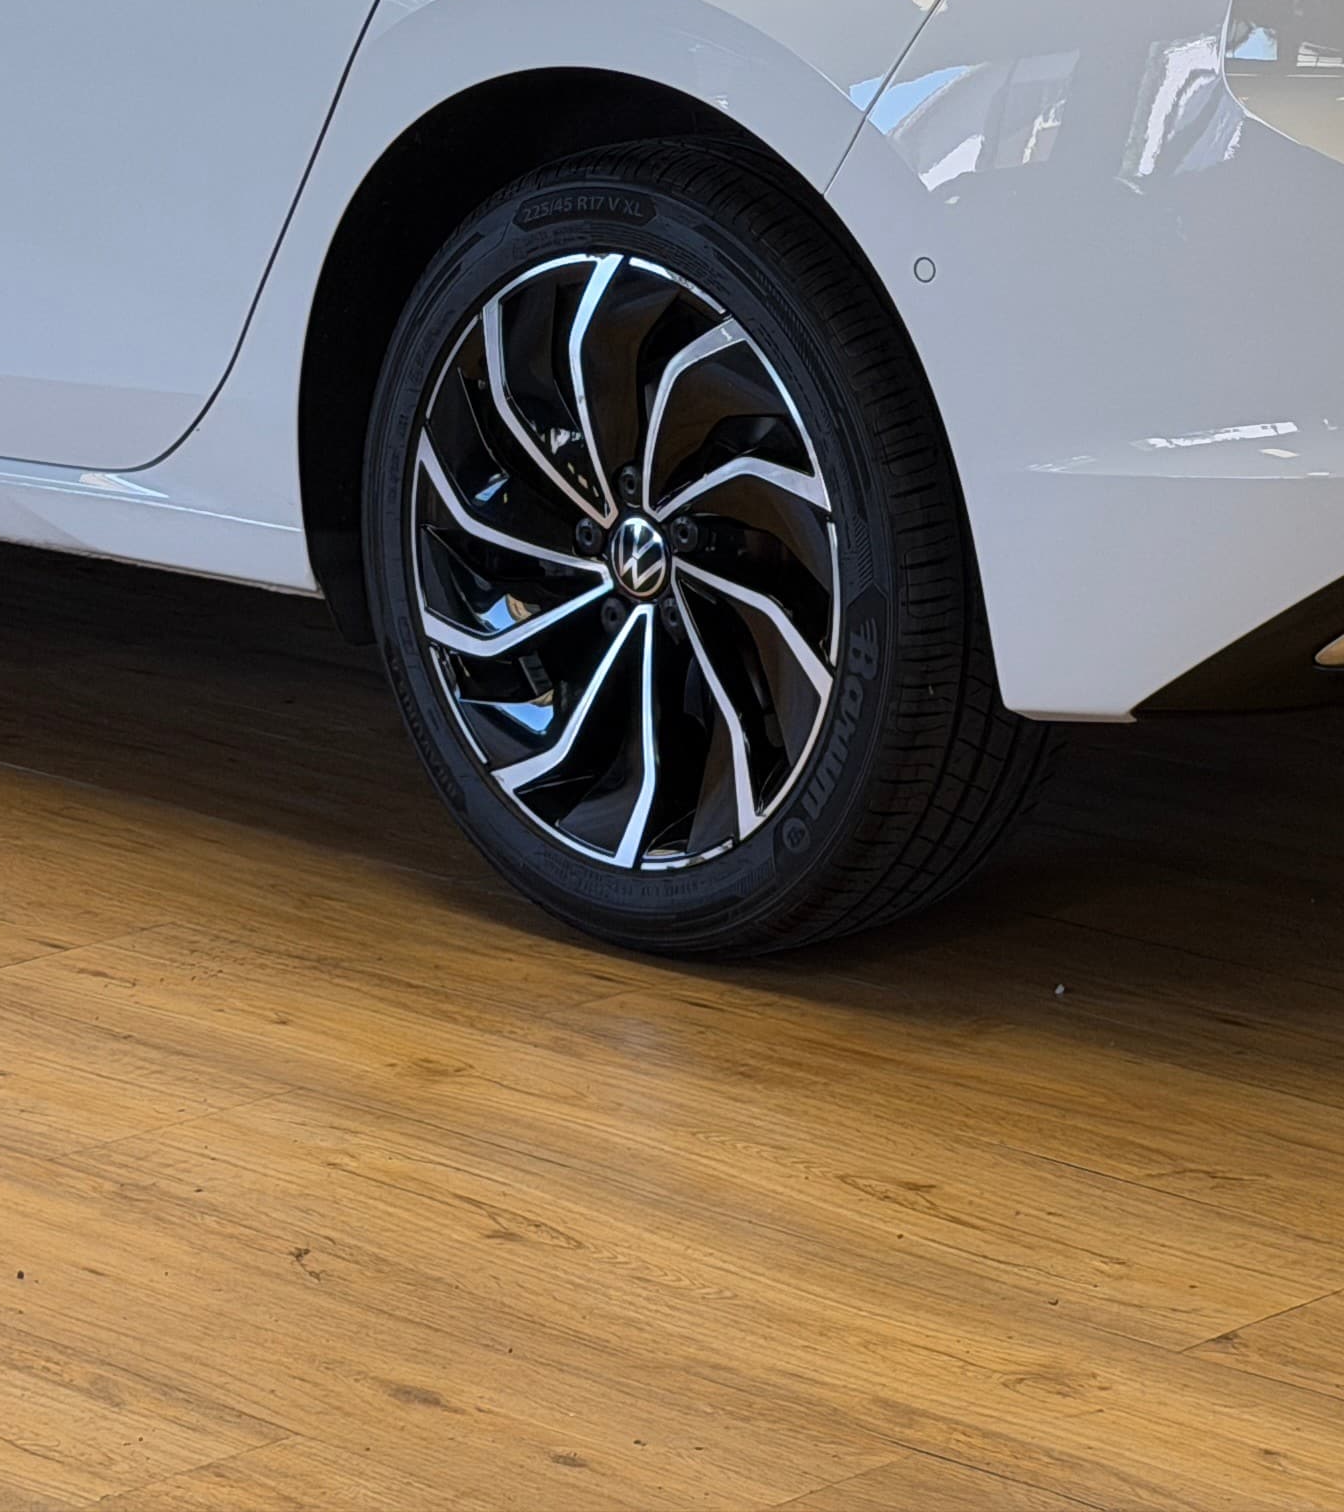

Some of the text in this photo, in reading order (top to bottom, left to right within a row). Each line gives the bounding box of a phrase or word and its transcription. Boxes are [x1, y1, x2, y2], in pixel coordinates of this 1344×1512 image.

[523, 196, 644, 223] 225/45 R17 V XL
[800, 617, 879, 821] Barum
